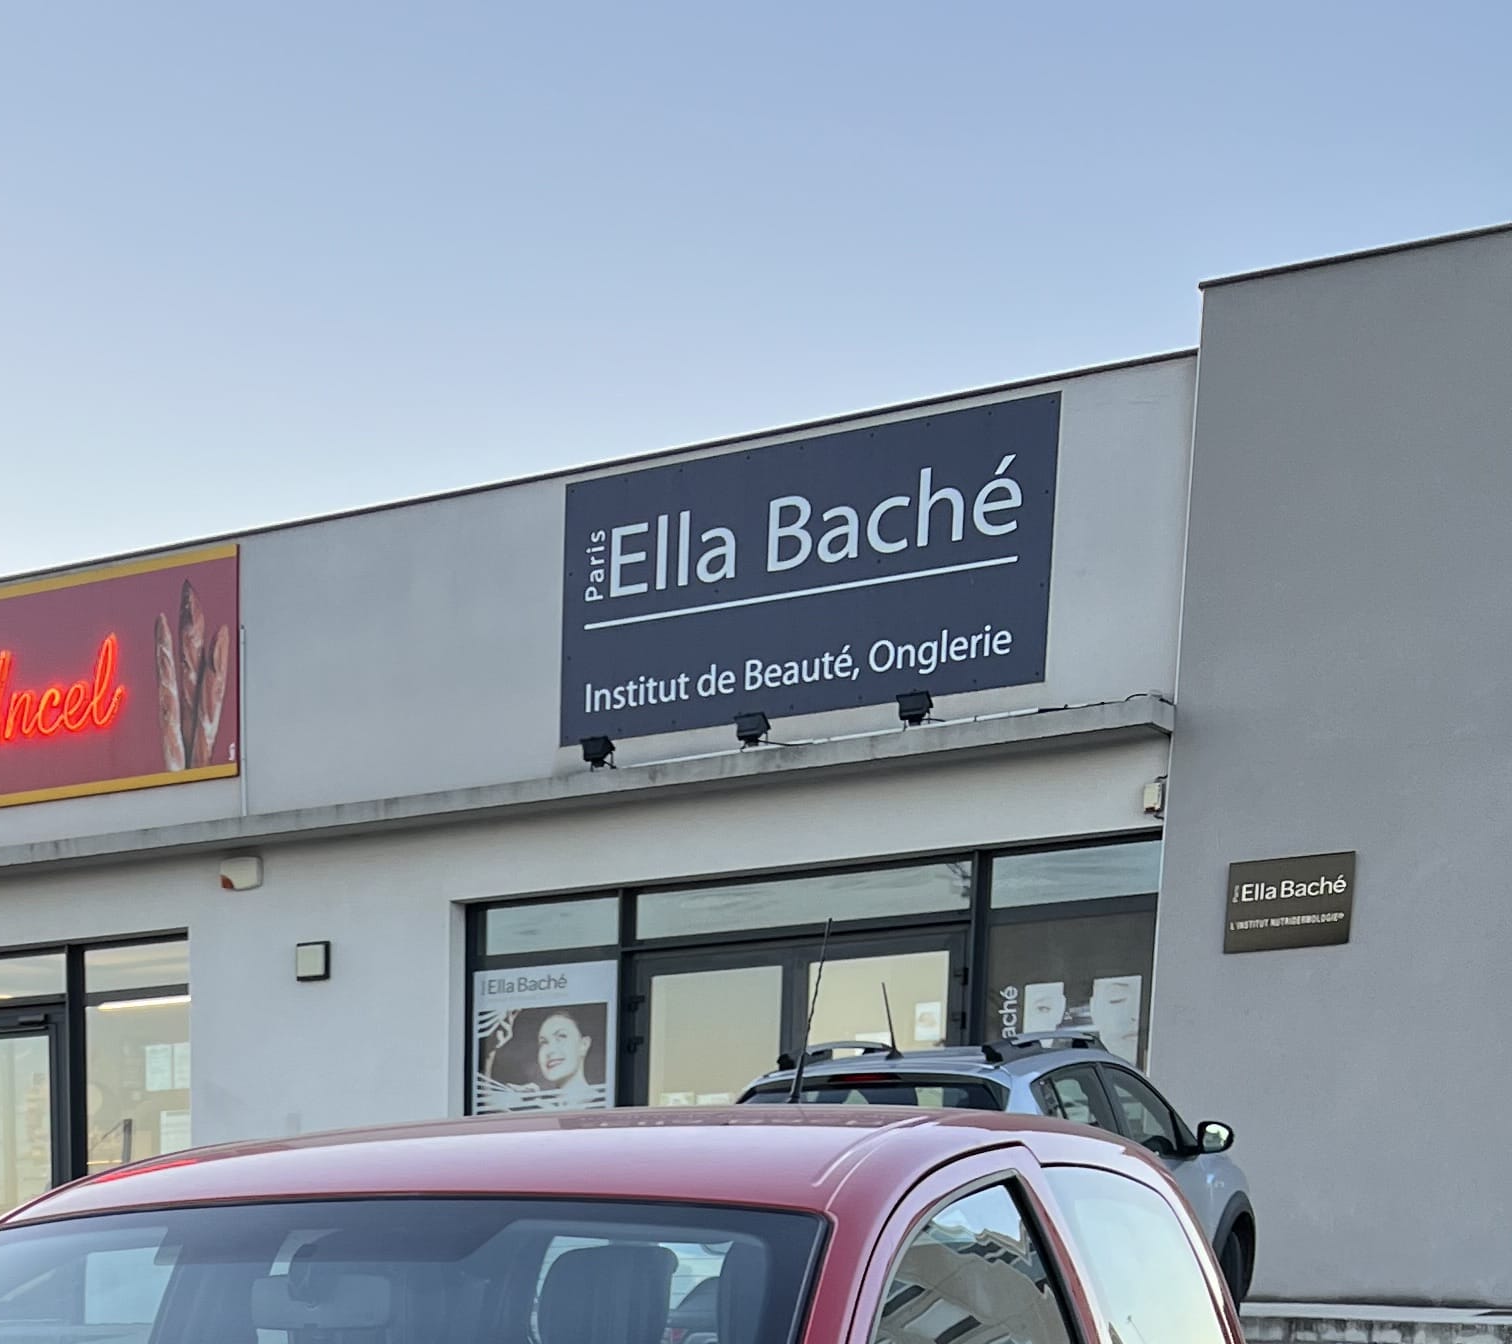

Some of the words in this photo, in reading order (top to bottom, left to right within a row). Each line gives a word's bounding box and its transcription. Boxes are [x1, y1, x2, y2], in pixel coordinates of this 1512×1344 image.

[609, 510, 737, 598] Ella
[765, 453, 1024, 572] Baché
[584, 529, 606, 602] Paris
[584, 672, 690, 713] Institut
[697, 663, 736, 697] de
[744, 645, 860, 692] Beauté,
[868, 623, 1013, 677] Onglerie
[1241, 883, 1277, 902] Ella
[1280, 874, 1347, 898] Baché
[488, 979, 514, 994] Ella
[517, 973, 567, 992] Baché
[999, 985, 1018, 1039] aché
